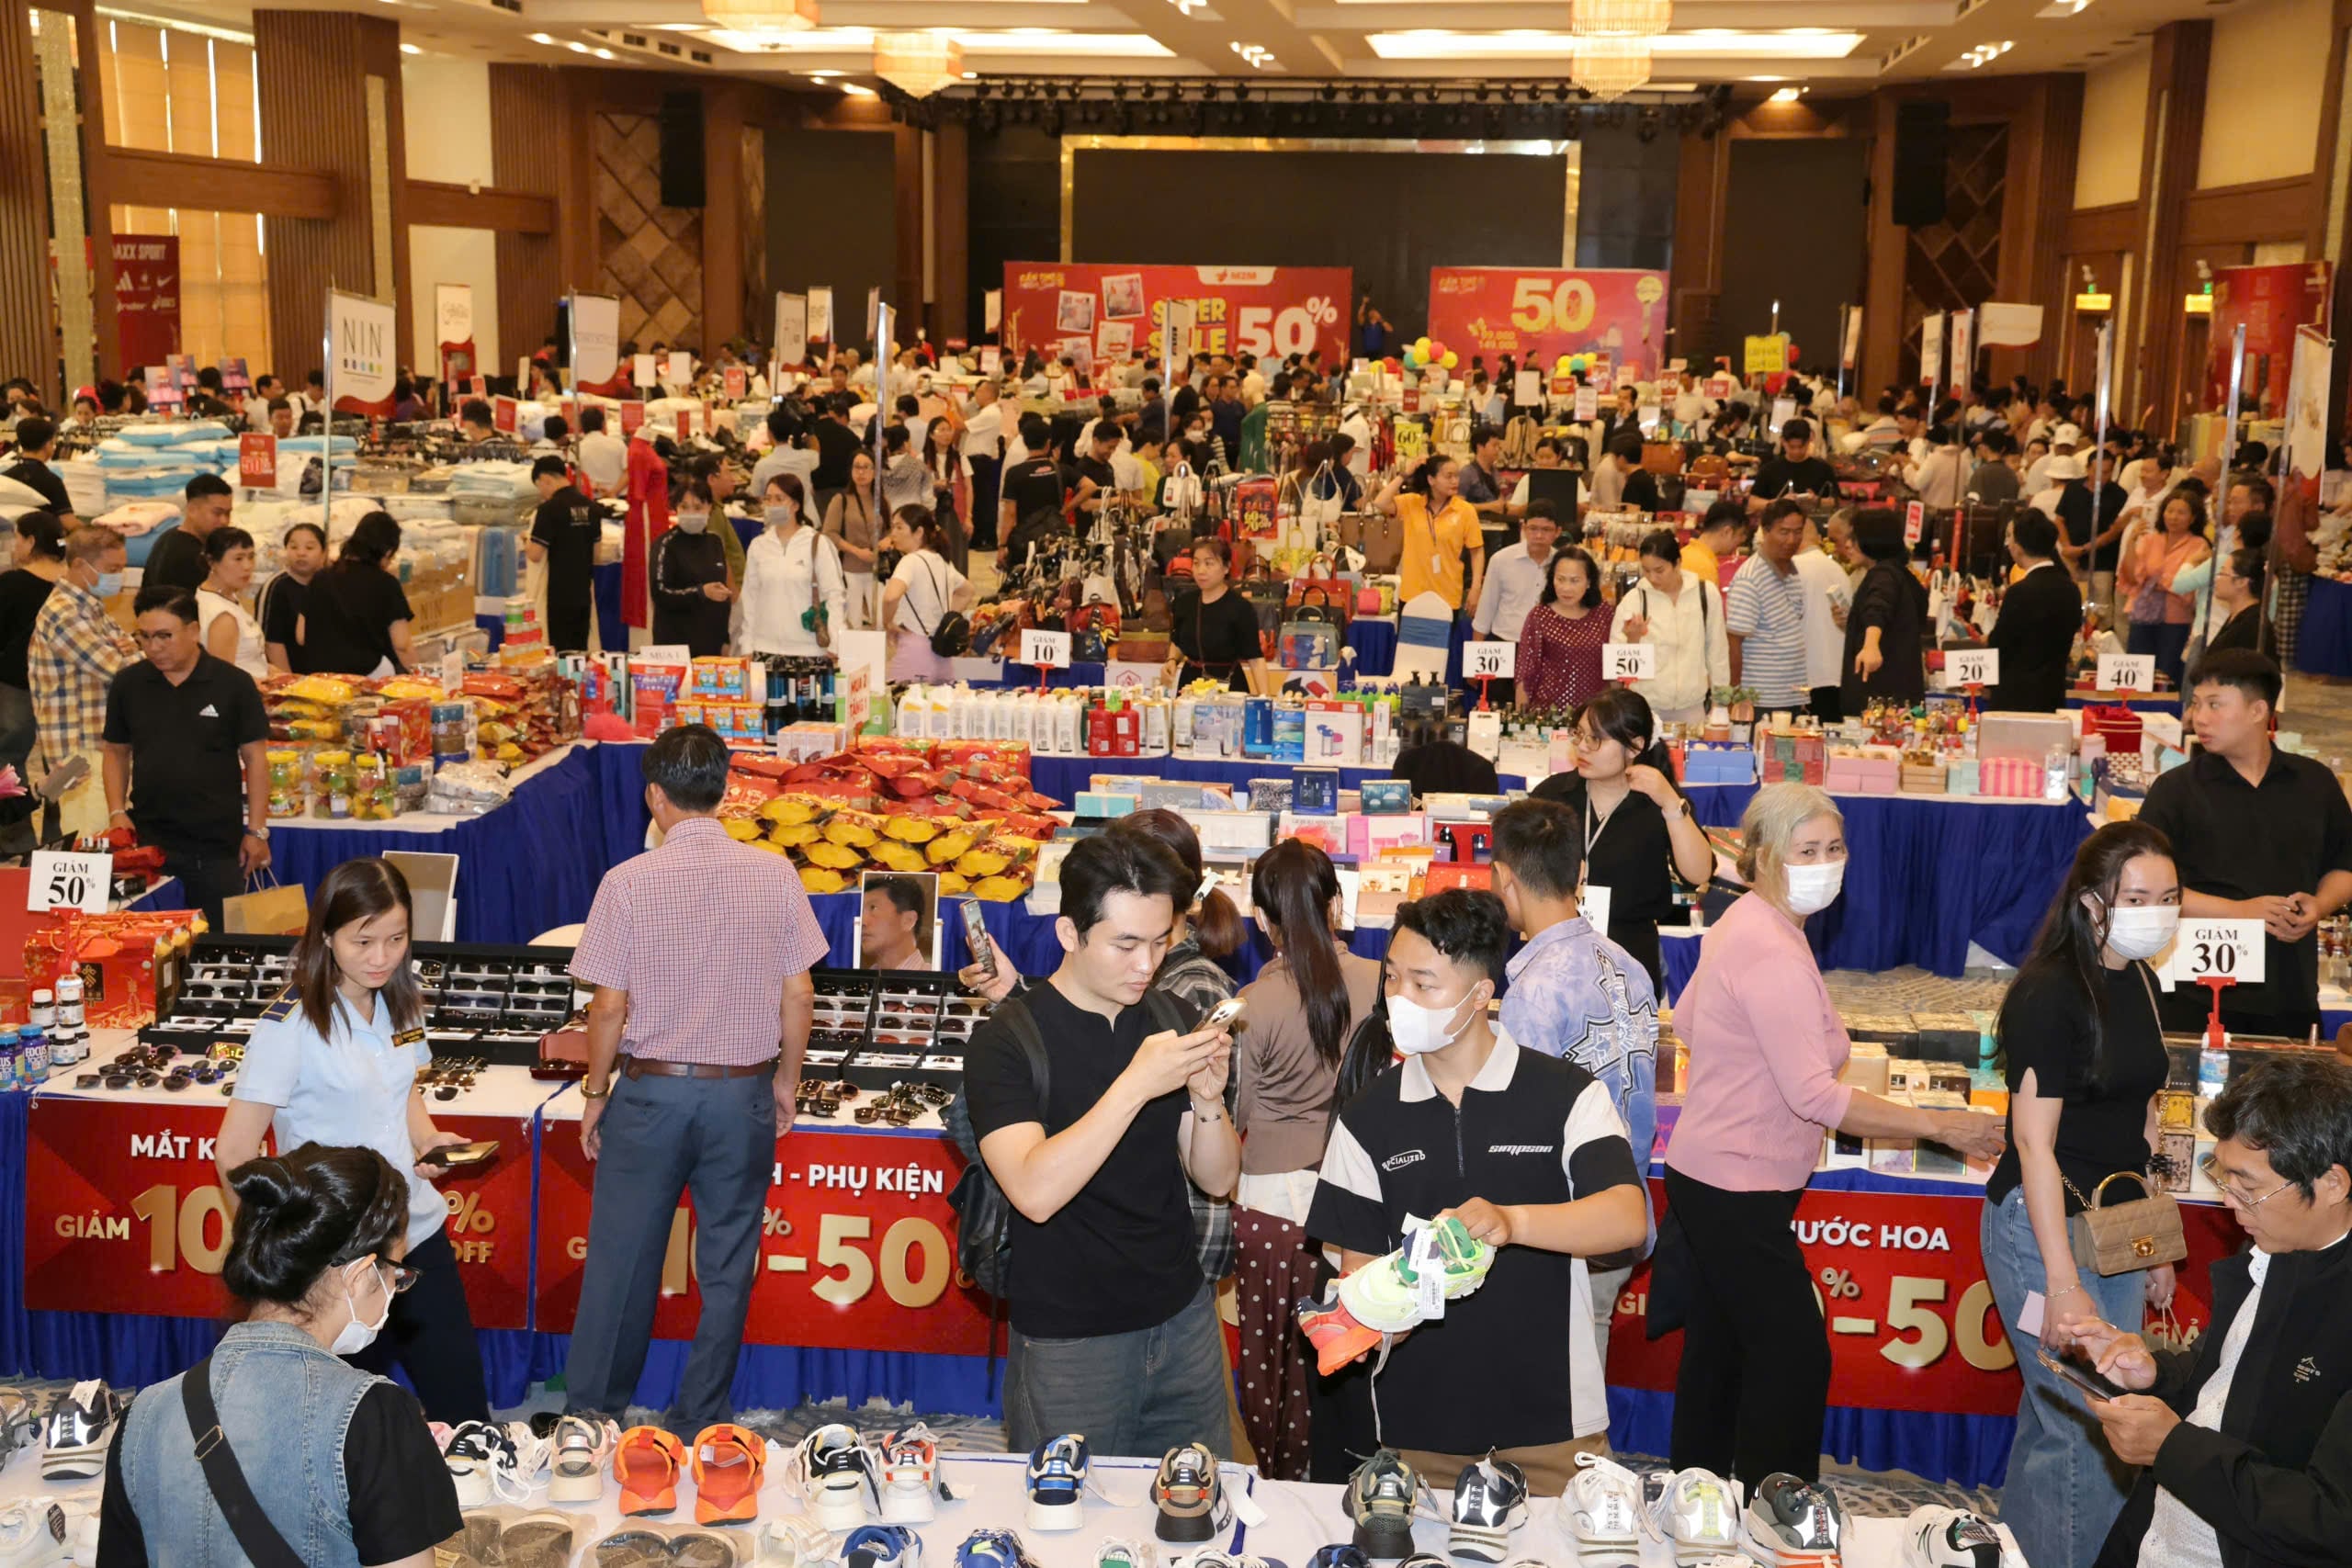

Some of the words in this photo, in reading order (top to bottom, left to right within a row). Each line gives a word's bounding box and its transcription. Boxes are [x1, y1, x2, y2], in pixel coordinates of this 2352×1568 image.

[1152, 298, 1227, 323] SER
[1510, 278, 1596, 333] 50
[343, 317, 382, 358] NIN
[1148, 329, 1227, 358] SLE
[52, 859, 89, 874] GIẢM
[2195, 925, 2238, 941] GIẢM
[25, 1045, 47, 1057] FOCUS
[131, 1128, 190, 1159] MẮT
[808, 1164, 867, 1197] PHỤ
[876, 1162, 944, 1201] KIỆN
[55, 1209, 130, 1240] GIẢM
[1790, 1216, 1871, 1247] ƯỚC
[1880, 1224, 1951, 1251] HOA
